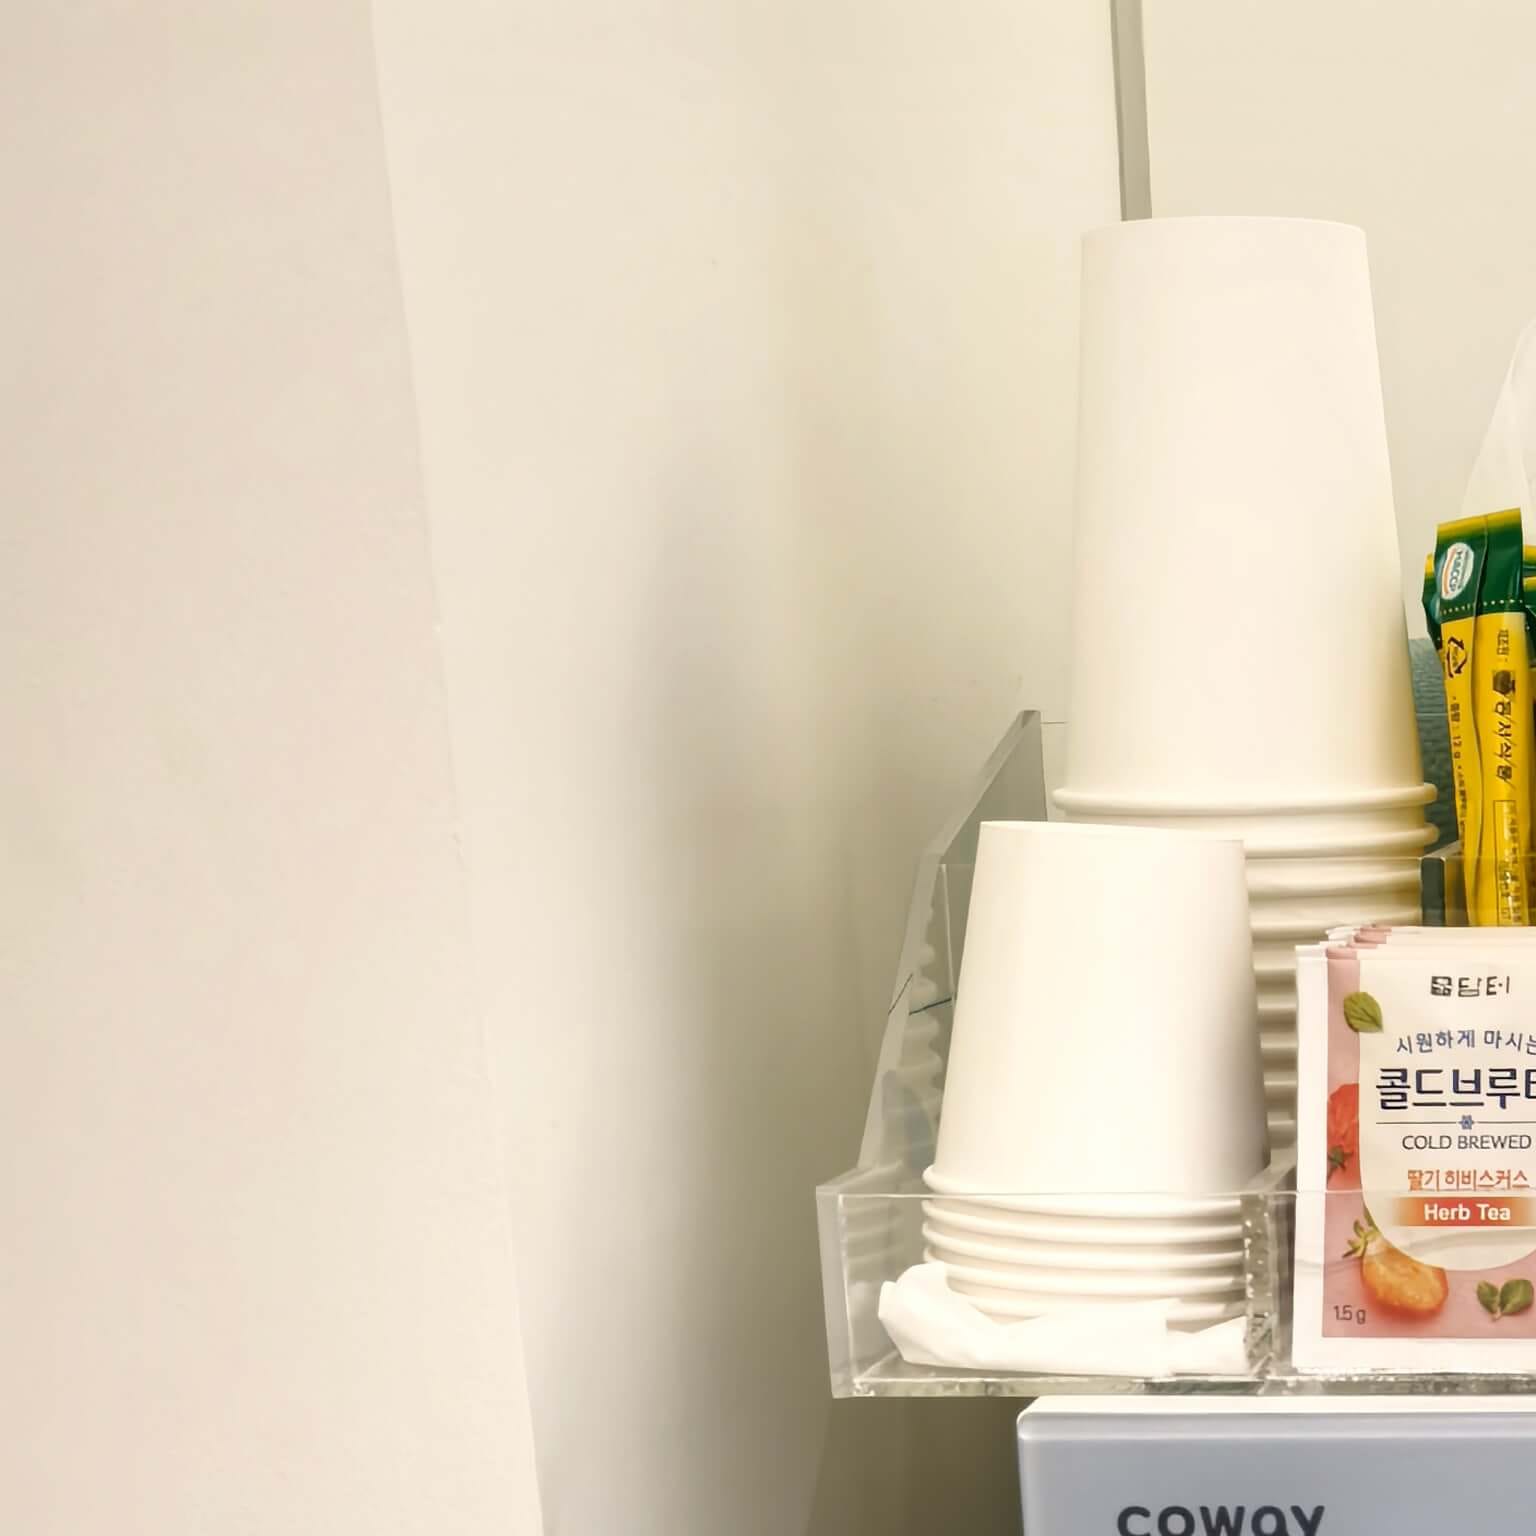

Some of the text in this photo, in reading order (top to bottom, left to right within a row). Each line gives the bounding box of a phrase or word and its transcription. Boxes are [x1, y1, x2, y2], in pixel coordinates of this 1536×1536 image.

[1396, 1029, 1476, 1055] 시원하게
[1402, 1134, 1532, 1150] COLD BREWED
[1407, 1168, 1531, 1192] 딸기 히비스커스
[1424, 1203, 1511, 1221] Herb Tea
[1356, 1308, 1367, 1325] g
